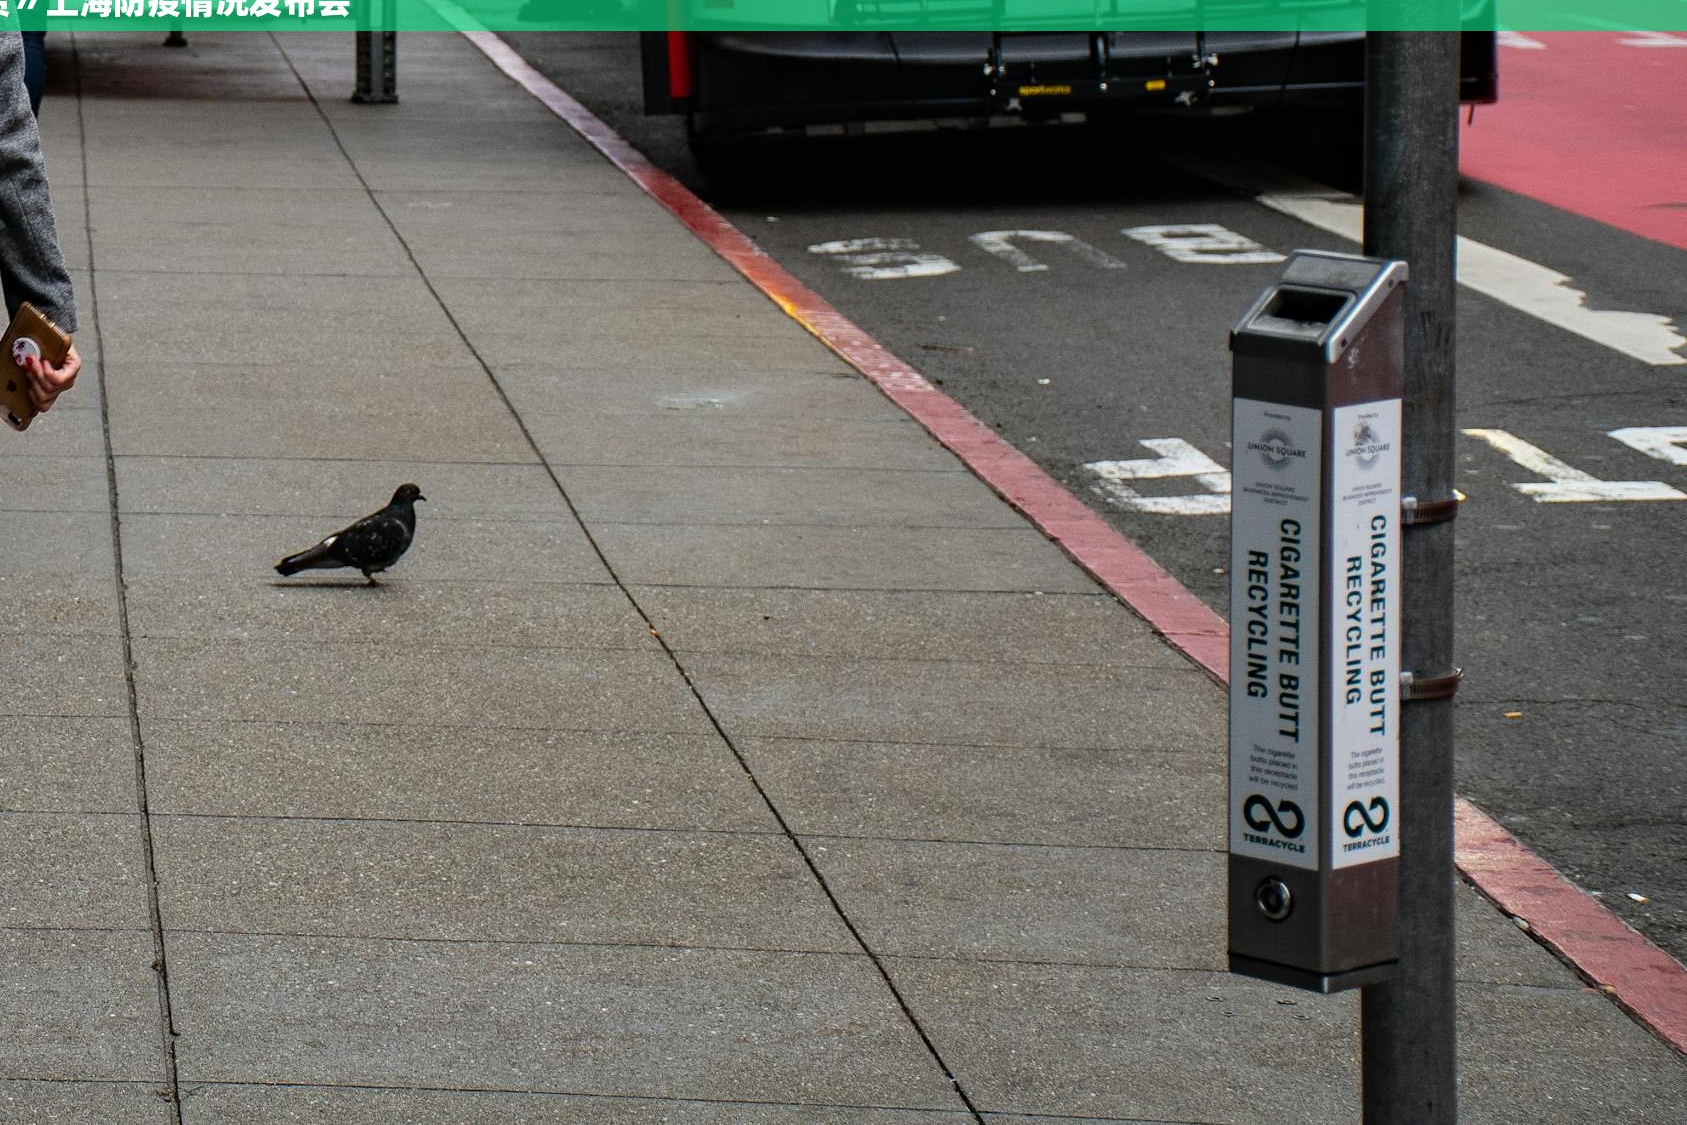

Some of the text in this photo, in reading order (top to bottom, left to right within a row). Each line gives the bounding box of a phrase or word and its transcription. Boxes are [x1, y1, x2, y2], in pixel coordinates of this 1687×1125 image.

[1248, 442, 1307, 459] UNION SQUARE
[1346, 443, 1391, 457] UNION SQUARE
[1247, 549, 1269, 699] RECYCLING
[1278, 518, 1301, 743] CIGARETTE BUTT
[1346, 555, 1362, 705] RECYCLING
[1369, 515, 1387, 736] CIGARETTE BUTT
[1244, 833, 1306, 853] TERRACYCLE
[1343, 836, 1391, 852] TERRACYCLE
